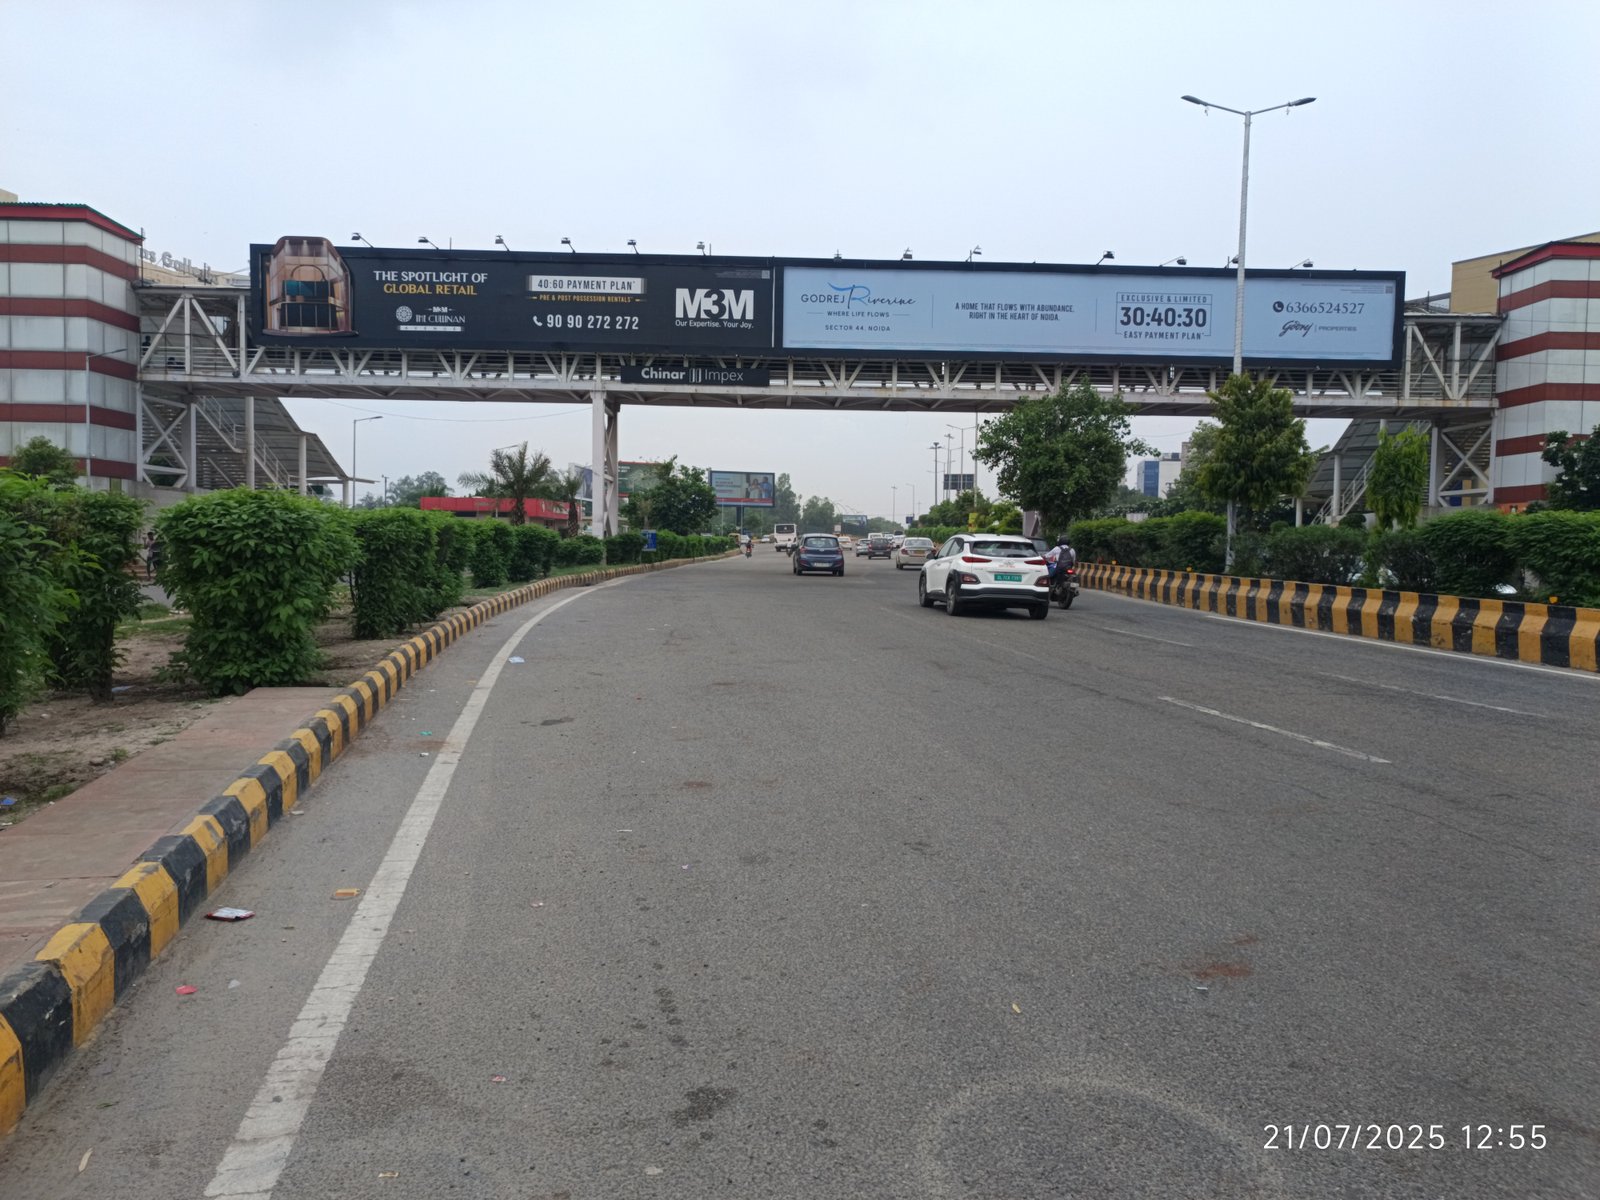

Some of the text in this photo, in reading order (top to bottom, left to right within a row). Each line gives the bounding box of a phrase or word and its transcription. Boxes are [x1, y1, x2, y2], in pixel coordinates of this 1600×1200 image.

[374, 270, 488, 283] THE SPOTLIGHT OF
[384, 283, 477, 295] GLOBAL RETAIL
[537, 279, 563, 289] 40:60
[567, 280, 607, 290] PAYMENT
[801, 282, 916, 309] GODREJ Riverine
[675, 288, 754, 320] M3M
[1286, 301, 1365, 314] 6366524527
[547, 314, 639, 329] 90 90 272 272
[1120, 306, 1207, 327] 30:40:30
[1124, 331, 1142, 339] EASY
[1145, 331, 1179, 340] PAYMENT
[641, 367, 743, 384] Chinar Impex
